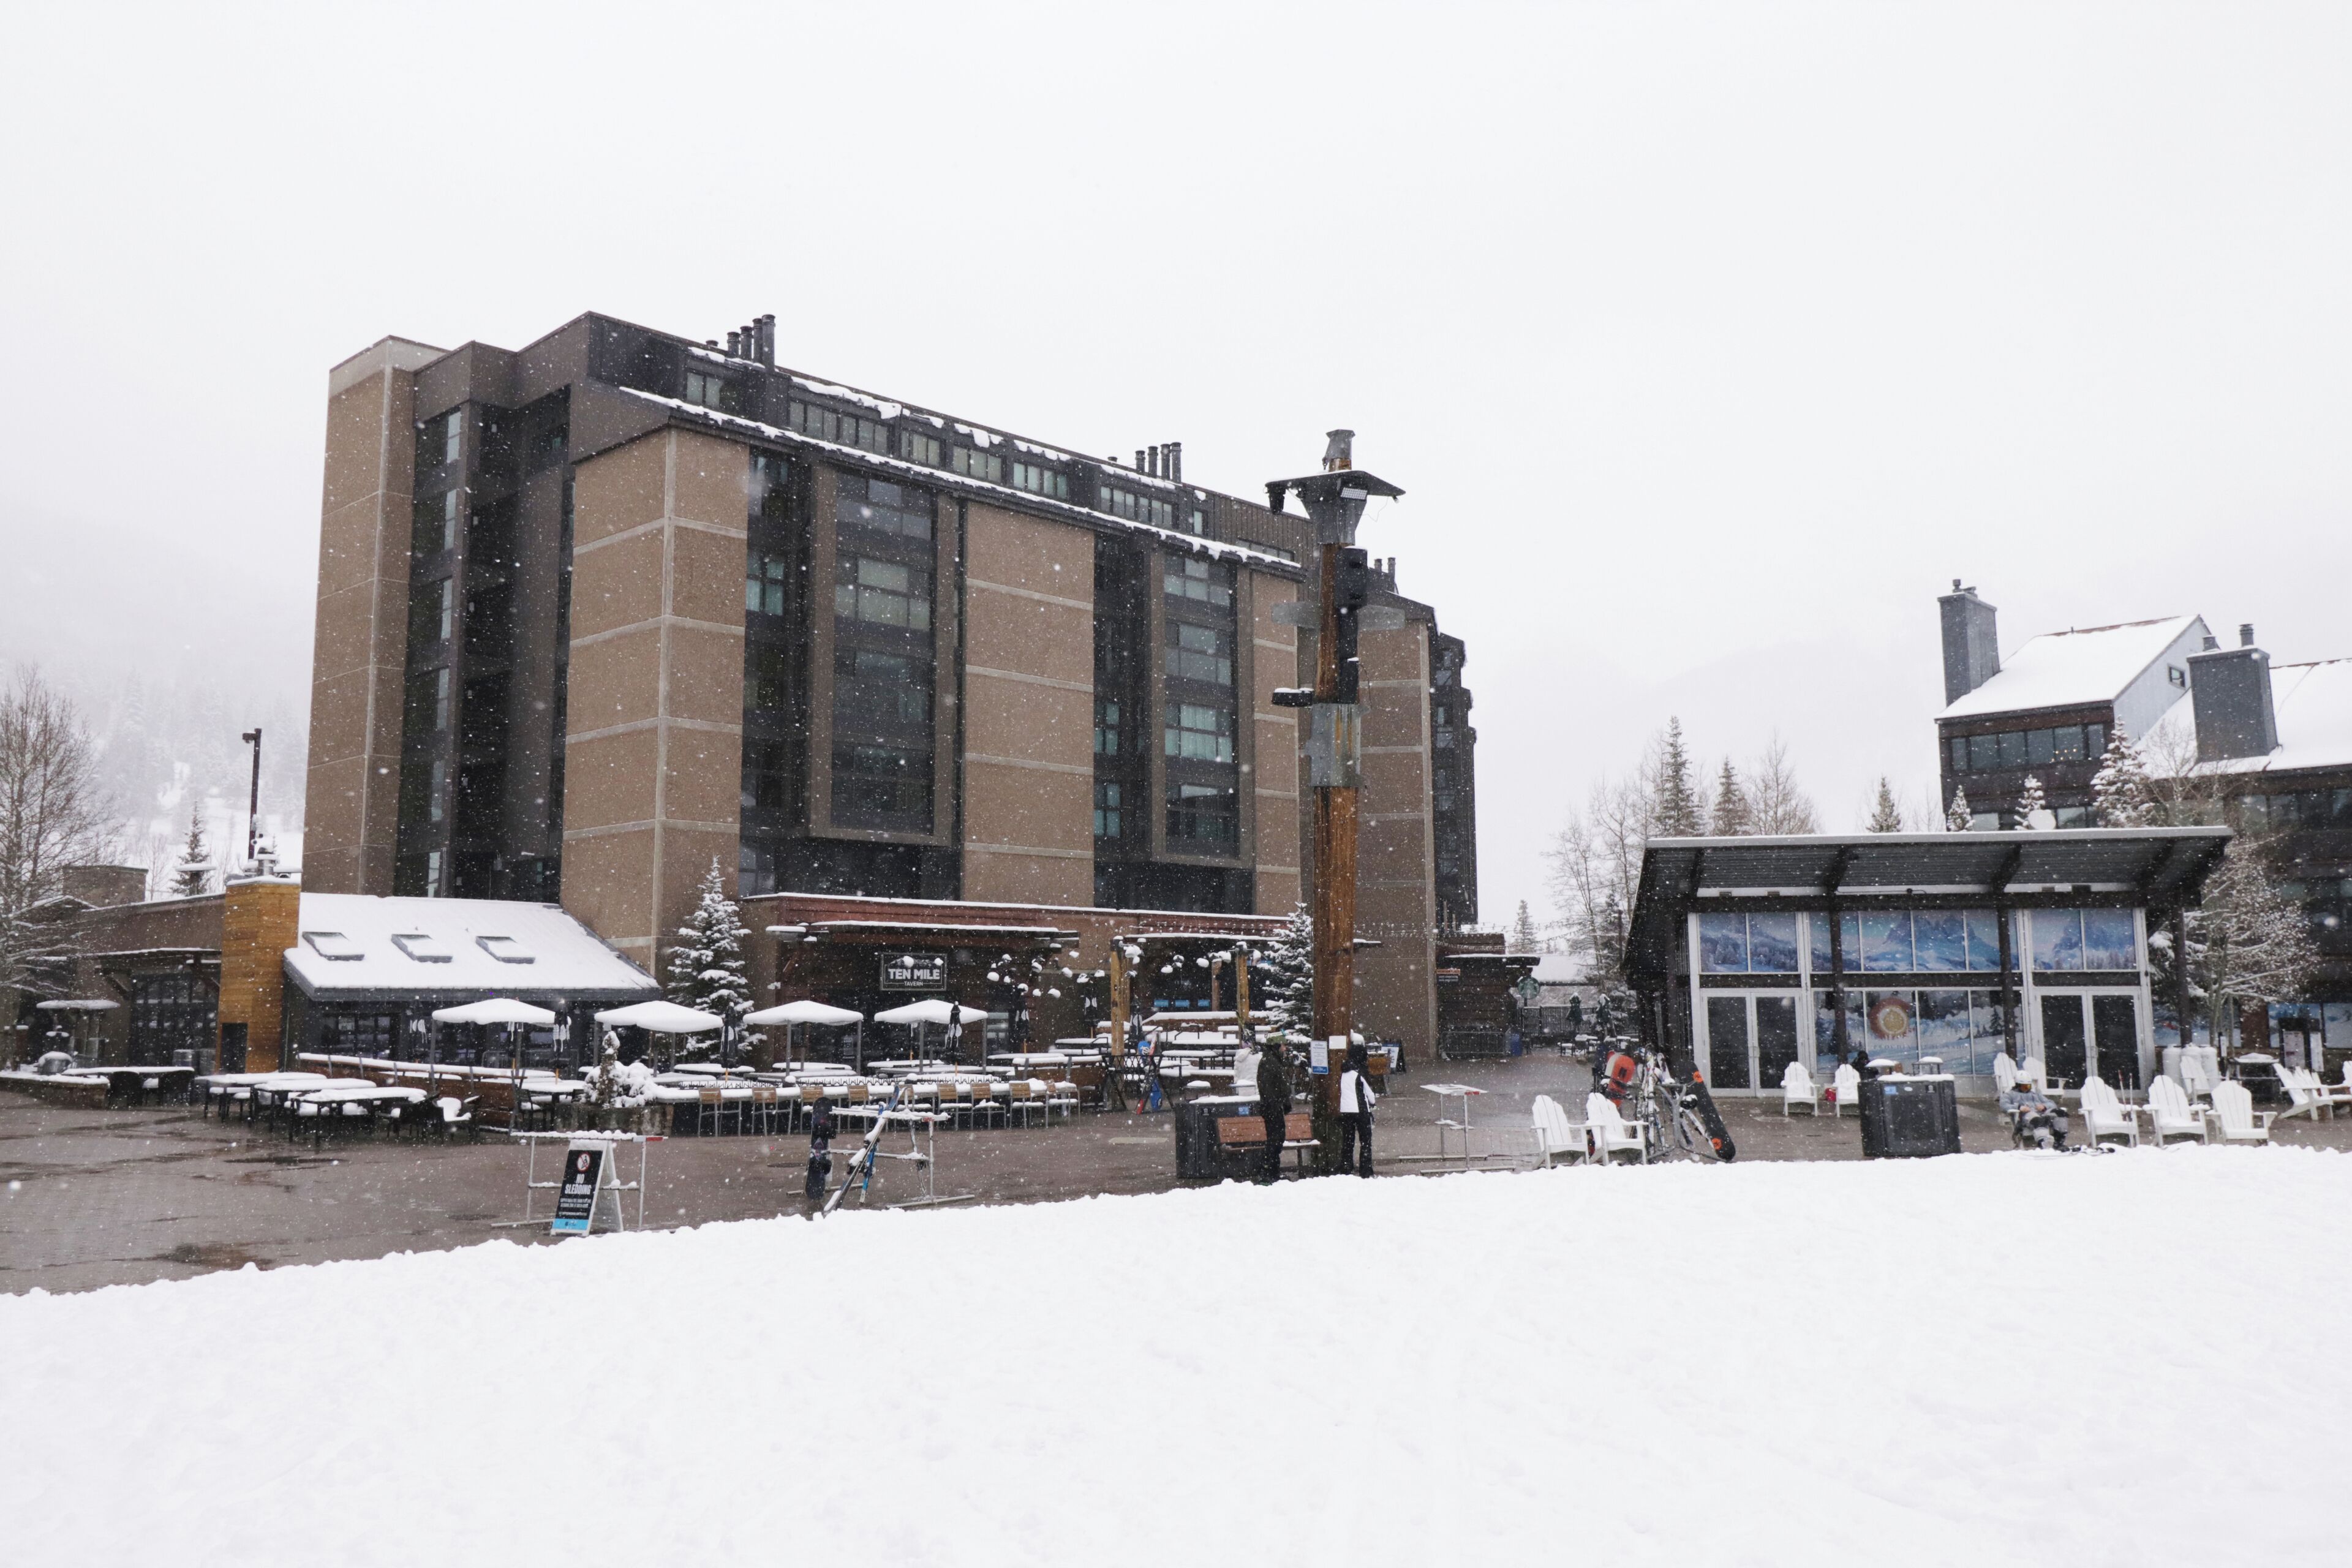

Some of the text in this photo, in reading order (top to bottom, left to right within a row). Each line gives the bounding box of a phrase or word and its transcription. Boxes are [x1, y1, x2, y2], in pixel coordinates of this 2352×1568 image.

[888, 969, 940, 979] TEN MILE
[576, 1174, 585, 1183] NO
[565, 1184, 592, 1194] SLEDDING
